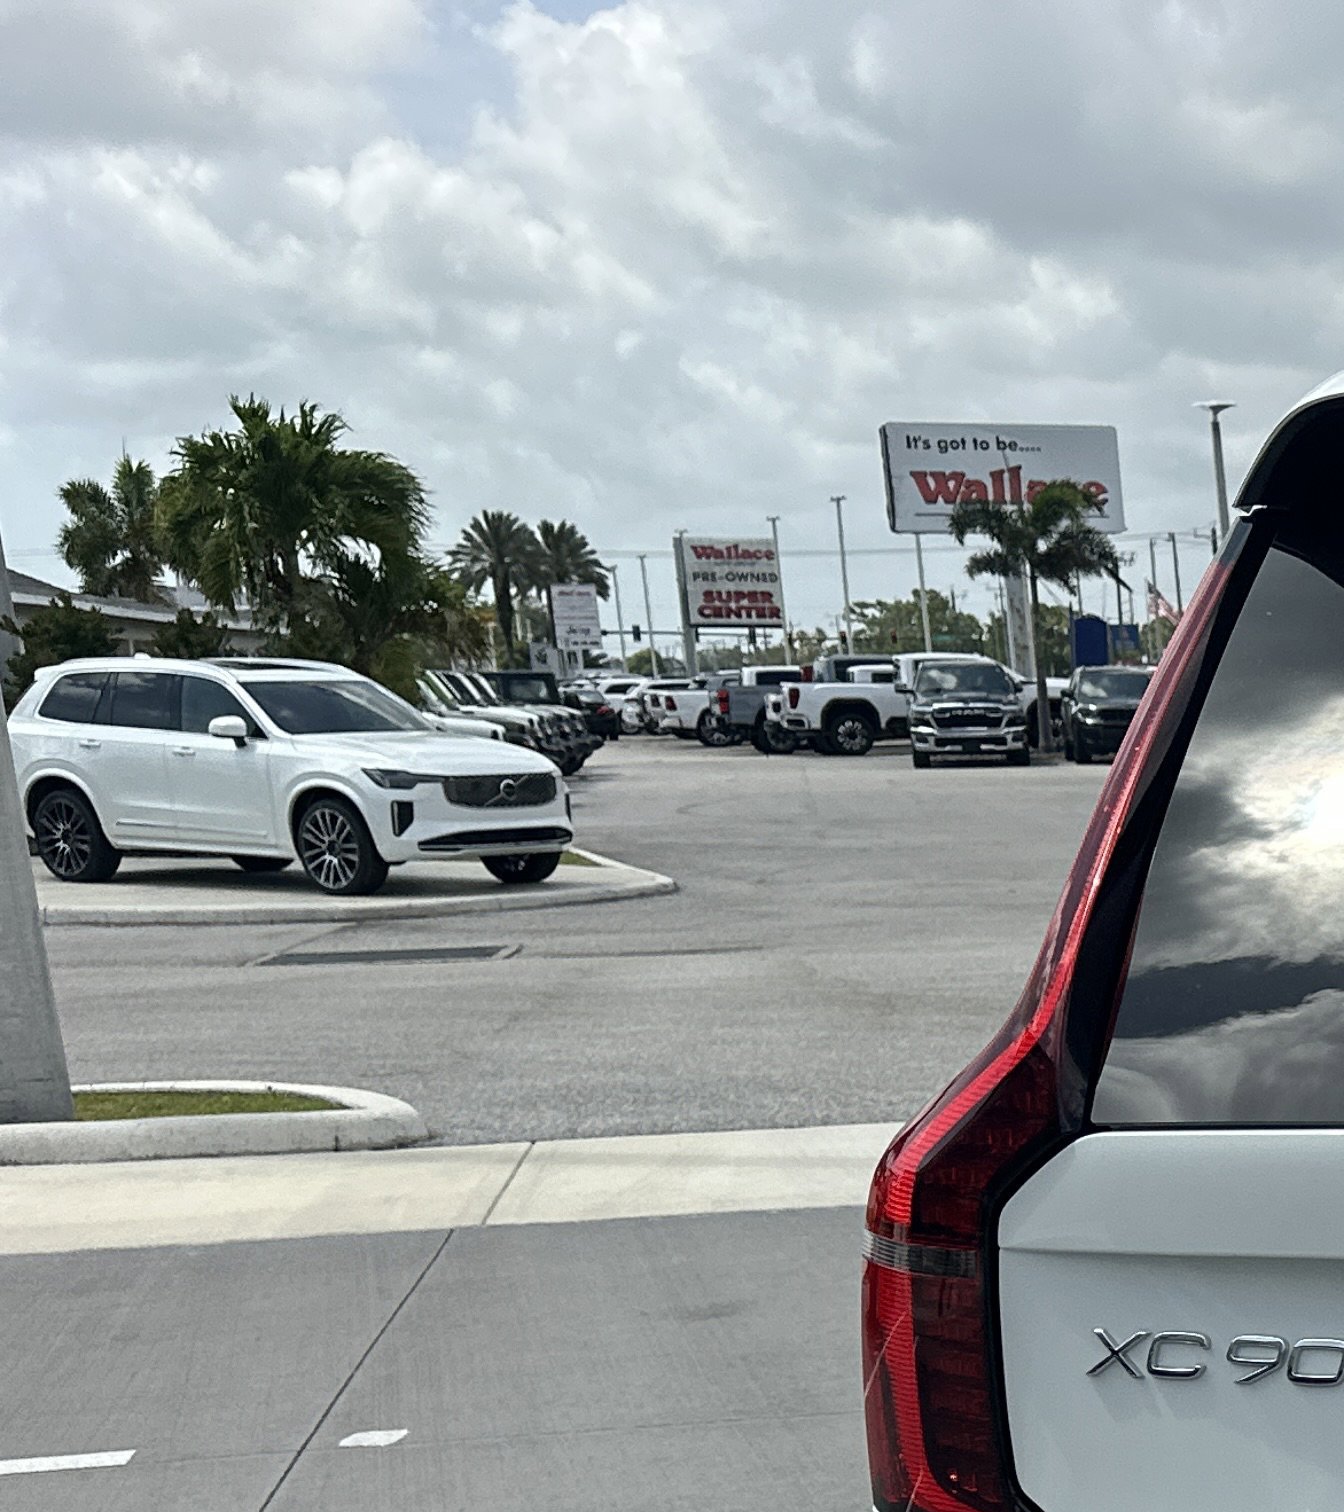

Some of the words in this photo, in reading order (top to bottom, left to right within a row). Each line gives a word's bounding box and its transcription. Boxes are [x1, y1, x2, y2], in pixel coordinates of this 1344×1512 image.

[906, 435, 931, 450] It's
[937, 437, 967, 454] got
[972, 437, 990, 451] to
[909, 464, 1109, 507] Wallae
[690, 543, 775, 560] Wallace
[692, 571, 779, 583] PRE-OWNED
[702, 590, 774, 604] SUPER
[697, 604, 782, 619] CENTER
